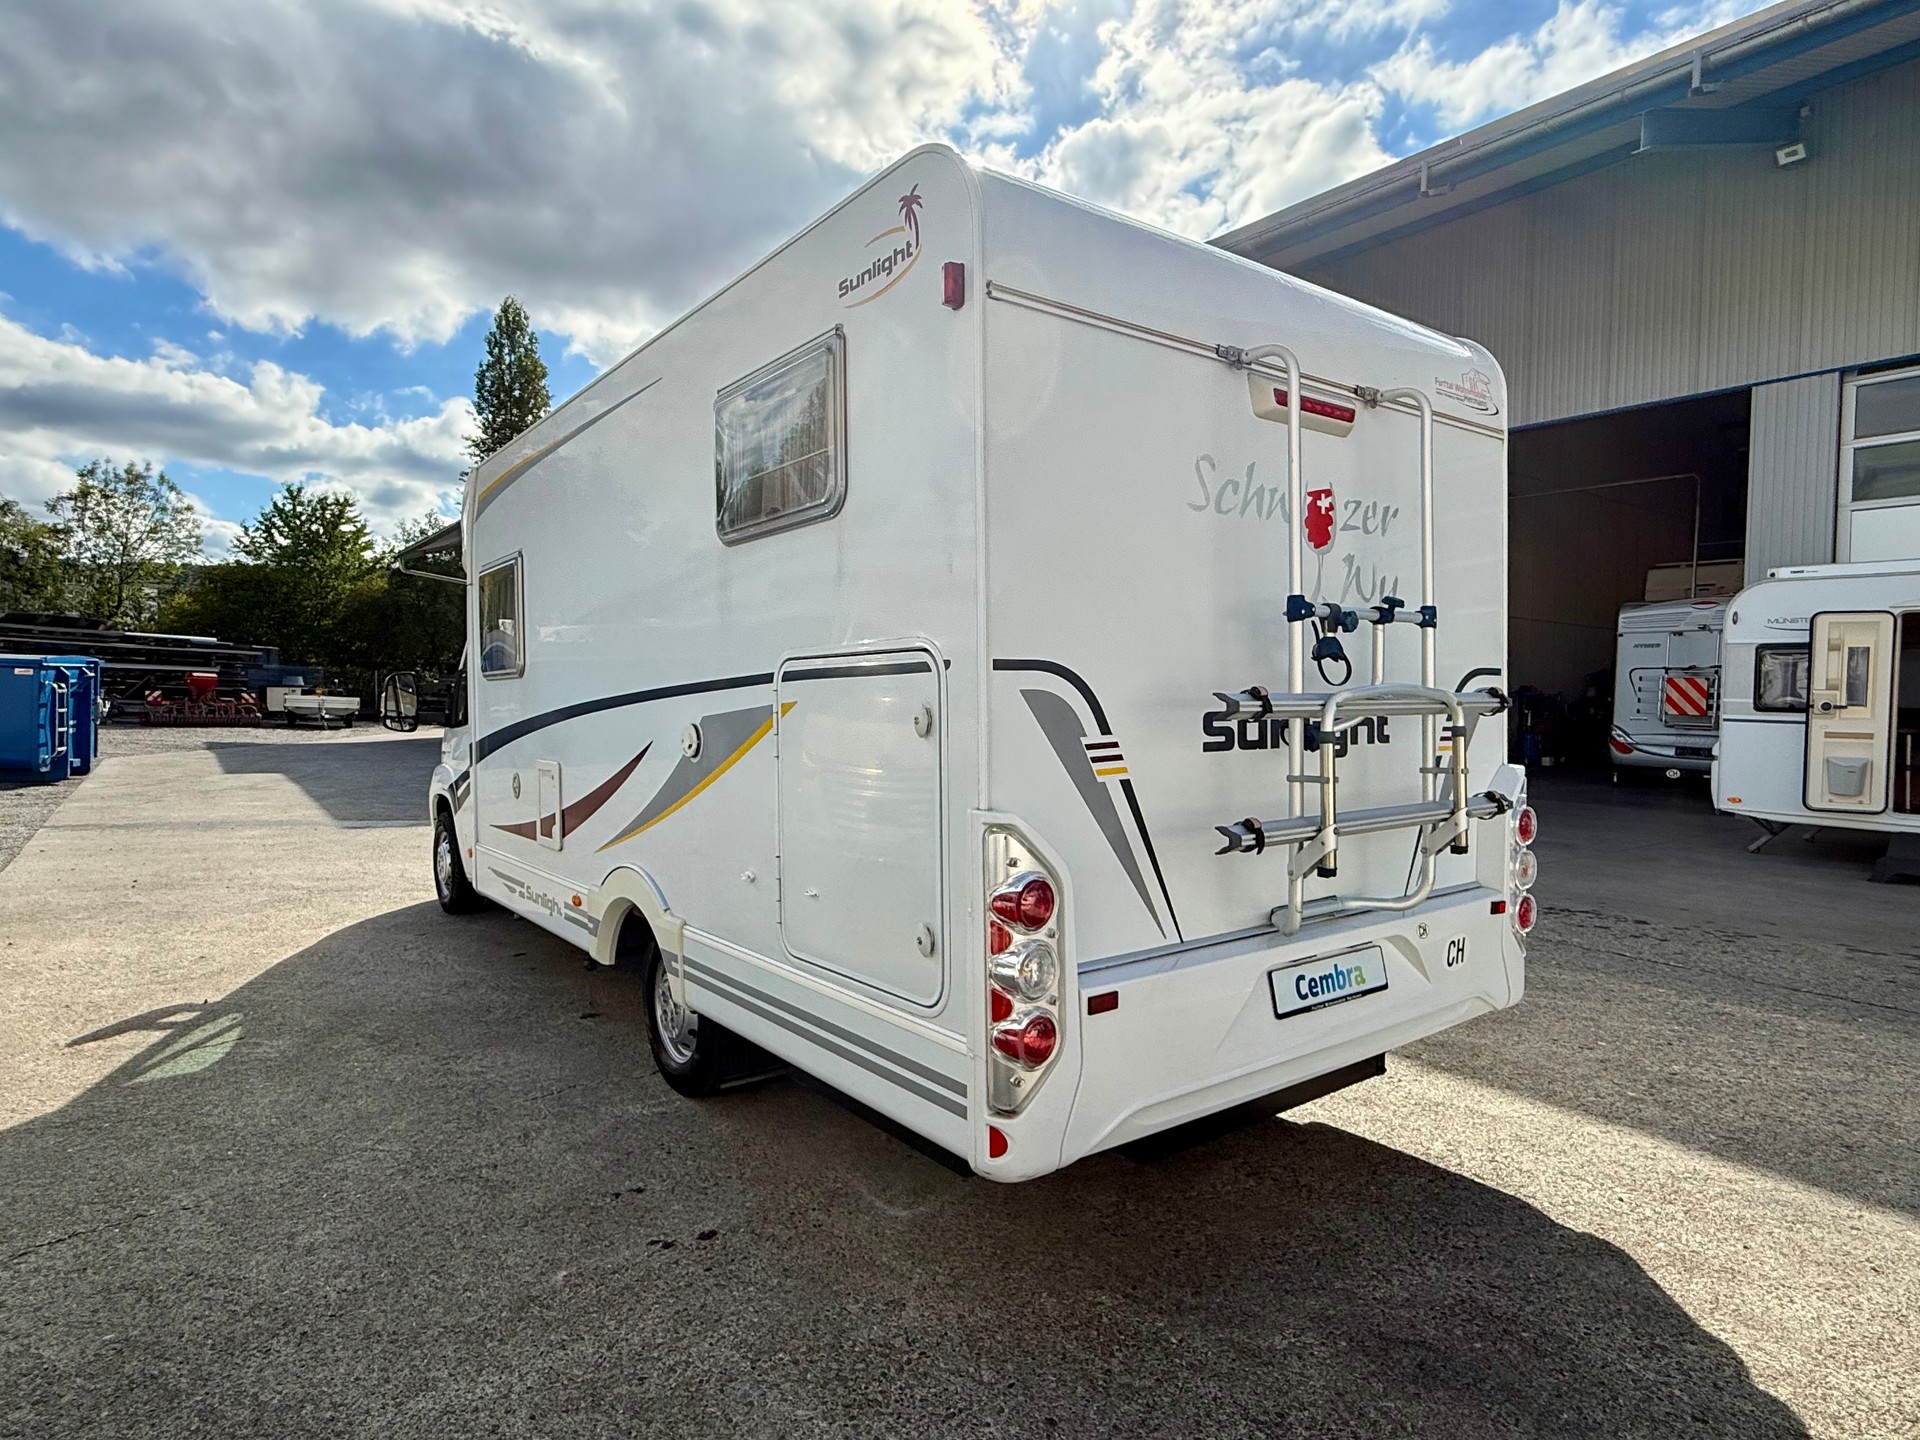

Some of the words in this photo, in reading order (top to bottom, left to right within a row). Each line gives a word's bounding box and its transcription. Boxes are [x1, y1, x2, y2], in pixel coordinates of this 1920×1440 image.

[838, 240, 914, 299] Sunlight
[1668, 769, 1678, 777] CH
[525, 885, 563, 917] Sunlight
[1446, 937, 1466, 968] CH
[1295, 963, 1366, 1001] Cembra
